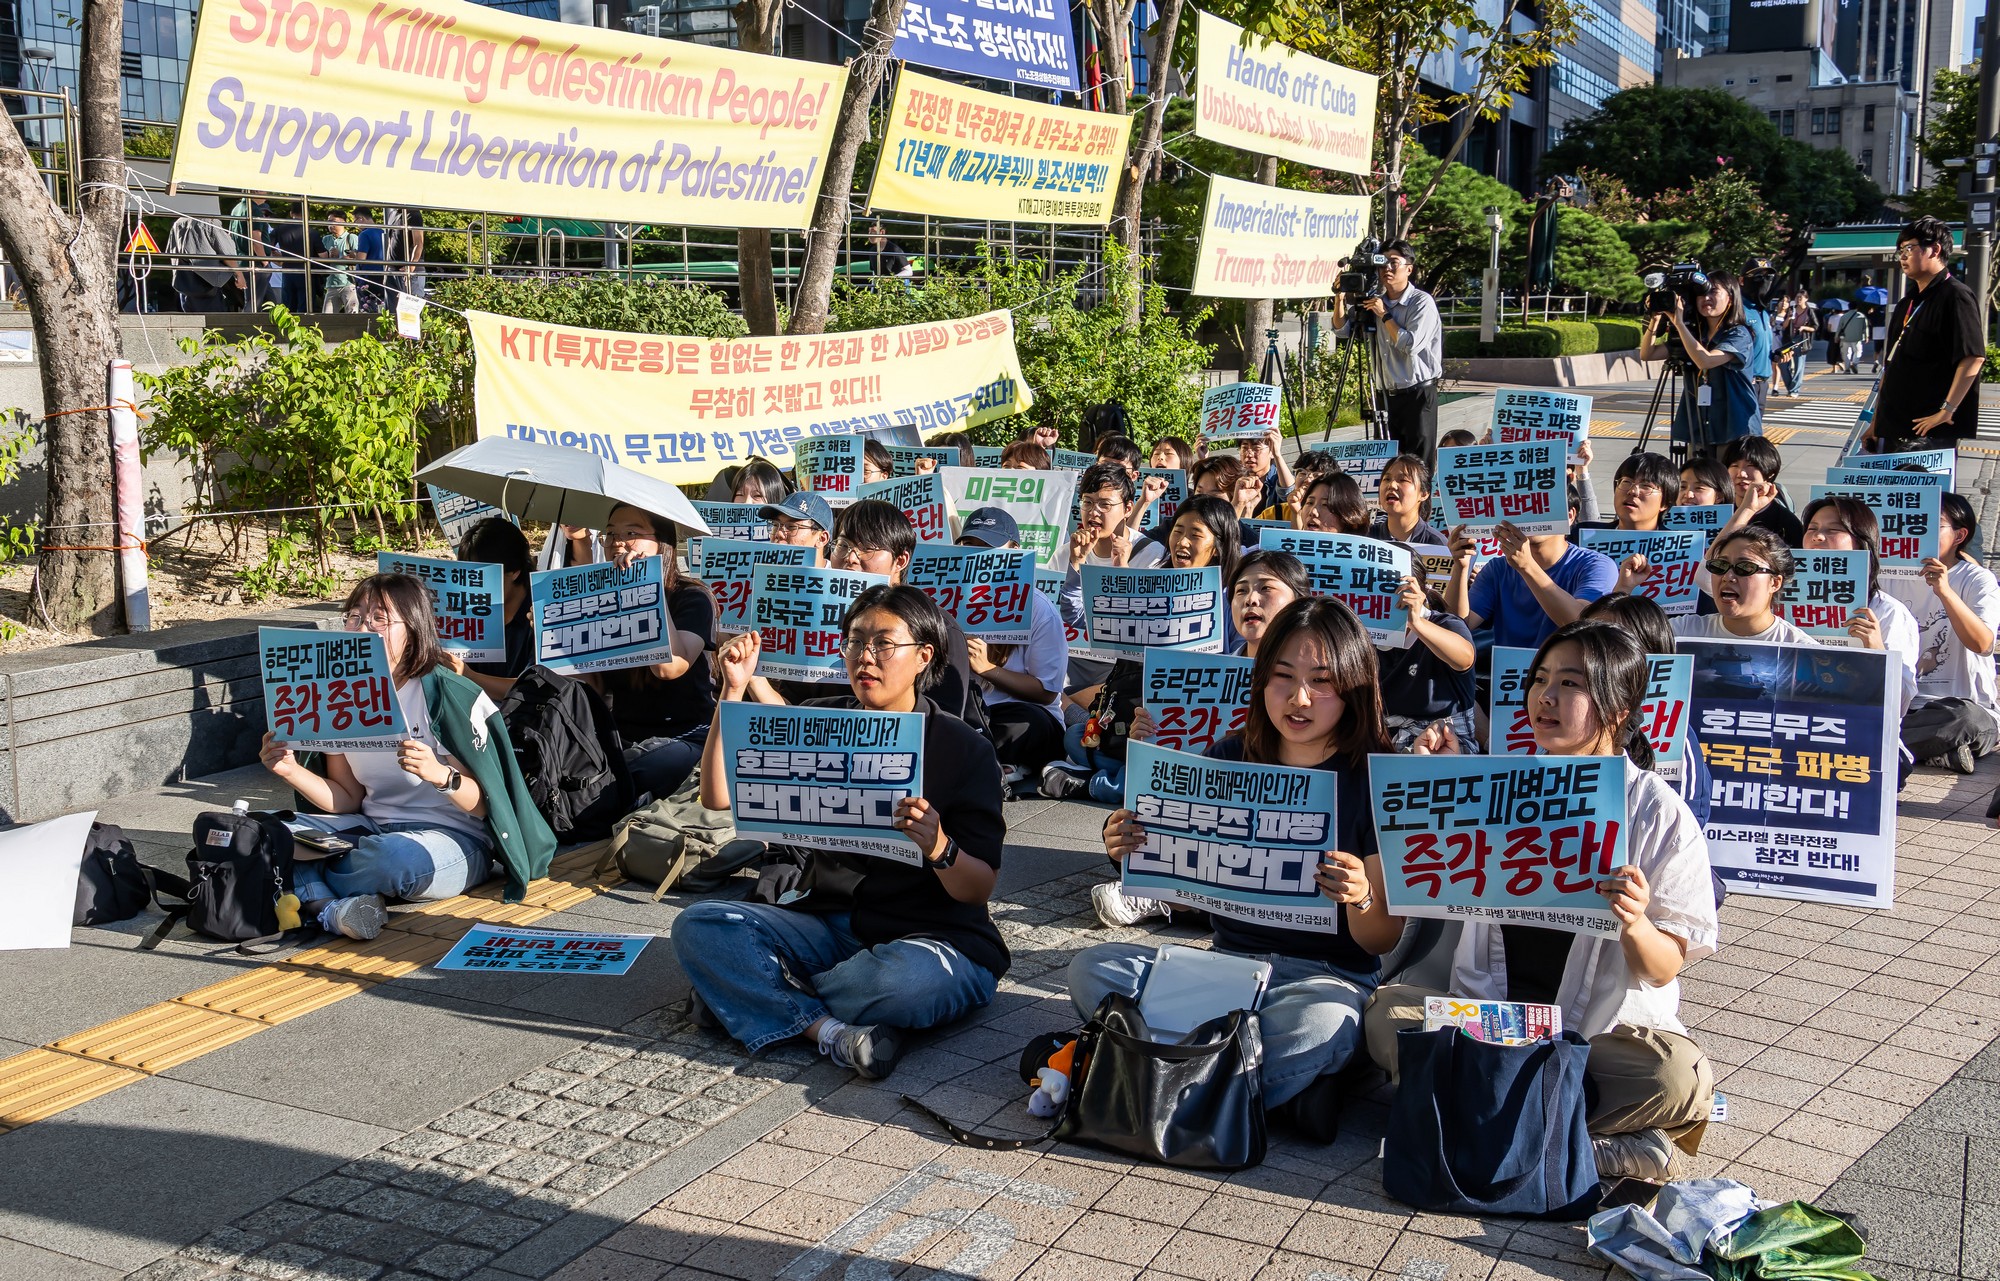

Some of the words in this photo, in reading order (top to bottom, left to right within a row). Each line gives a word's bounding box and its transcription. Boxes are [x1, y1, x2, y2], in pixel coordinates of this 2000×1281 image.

[972, 18, 1069, 70] 쟁취하자!!
[230, 0, 350, 76] Stop
[357, 2, 497, 103] Killing
[500, 36, 703, 118] Palestinian
[707, 67, 830, 140] People!
[1226, 44, 1289, 98] Hands
[1292, 71, 1319, 107] off
[1321, 79, 1356, 116] Cuba
[904, 88, 952, 134] 진정한
[955, 101, 1024, 146] 민주공화국
[1021, 116, 1036, 145] &
[1034, 117, 1087, 153] 민주노조
[1202, 84, 1264, 135] Unblock
[1267, 106, 1304, 146] Cuba!
[1307, 118, 1324, 150] No
[1325, 122, 1369, 161] Invasion!
[198, 77, 412, 177] Support
[410, 110, 617, 190] Liberation
[619, 139, 664, 193] of
[657, 143, 818, 204] Palestine!
[947, 148, 1034, 187] 해고자복직!!
[1214, 193, 1359, 239] Imperialist-Terrorist
[1214, 247, 1267, 287] Trump,
[1271, 252, 1306, 287] Step
[501, 325, 699, 375] KT(투자운용)은
[710, 343, 772, 374] 힘없는
[781, 340, 801, 371] 한
[806, 338, 864, 368] 가정과
[871, 333, 889, 362] 한
[895, 326, 949, 358] 사람의
[953, 315, 1008, 346] 인생을
[689, 381, 755, 419] 무참히
[764, 381, 823, 415] 짓밟고
[830, 374, 882, 407] 있다!!
[1204, 388, 1236, 413] 호르무즈
[1235, 386, 1273, 404] 파병검토
[1505, 394, 1550, 408] 호르무즈
[1554, 397, 1578, 411] 해협
[625, 432, 705, 464] 무고한
[711, 431, 737, 461] 한
[975, 378, 1014, 412] 있다!
[1205, 406, 1236, 434] 즉각
[1237, 403, 1277, 428] 중단!
[1497, 409, 1544, 427] 한국군
[1547, 413, 1581, 431] 파병
[828, 439, 850, 453] 해협
[1454, 451, 1514, 469] 호르무즈
[1519, 447, 1549, 464] 해협
[823, 456, 855, 473] 파병
[812, 474, 850, 492] 반대!
[965, 476, 1045, 504] 미국의
[1444, 472, 1507, 496] 한국군
[1513, 467, 1556, 491] 파병
[1455, 496, 1495, 519] 절대
[1500, 492, 1550, 516] 반대!
[1887, 492, 1920, 508] 해협
[1690, 511, 1717, 524] 해협
[1882, 513, 1928, 536] 파병
[702, 552, 752, 579] 호르무즈
[1280, 538, 1352, 559] 호르무즈
[1358, 543, 1394, 564] 해협
[1813, 557, 1848, 575] 해협
[451, 568, 484, 587] 해협
[552, 572, 586, 600] 청년들이
[588, 560, 648, 593] 방패막이인가?!
[765, 573, 823, 594] 호르무즈
[910, 556, 963, 586] 호르무즈
[962, 552, 1023, 584] 파병검토
[1101, 575, 1136, 594] 청년들이
[1138, 572, 1203, 594] 방패막이인가?!
[1350, 567, 1400, 593] 파병
[1640, 561, 1700, 598] 중단!
[445, 591, 492, 617] 파병
[543, 591, 617, 625] 호르무즈
[620, 581, 658, 609] 파병
[966, 583, 1030, 625] 중단!
[1093, 595, 1168, 614] 호르무즈
[1172, 592, 1214, 613] 파병
[1807, 579, 1855, 604] 파병
[757, 597, 814, 627] 한국군
[1792, 604, 1846, 629] 반대!
[434, 616, 484, 641] 반대!
[541, 608, 660, 660] 반대한다
[760, 627, 797, 655] 절대
[1093, 614, 1213, 644] 반대한다
[265, 643, 313, 683] 호르무즈
[316, 637, 373, 679] 파병검토
[1147, 668, 1221, 705] 호르무즈
[273, 681, 322, 736] 즉각
[327, 676, 392, 731] 중단!
[749, 716, 801, 746] 청년들이
[803, 716, 900, 747] 방패막이인가?!
[1155, 705, 1222, 751] 즉각
[1700, 708, 1846, 745] 호르무즈
[735, 748, 849, 781] 호르무즈
[851, 752, 917, 784] 파병
[1796, 750, 1871, 784] 파병
[1150, 760, 1202, 797] 청년들이
[1205, 769, 1311, 806] 방패막이인가?!
[1380, 774, 1484, 832] 호르무즈
[1485, 763, 1601, 826] 파병검토
[1135, 794, 1254, 841] 호르무즈
[1255, 809, 1330, 845] 파병
[782, 832, 810, 842] 호르무즈
[812, 835, 827, 845] 파병
[828, 837, 859, 849] 절대반대
[860, 840, 890, 853] 청년학생
[891, 846, 919, 860] 긴급집회
[1774, 833, 1838, 850] 침략전쟁
[1128, 830, 1325, 897] 반대한다
[1401, 829, 1493, 899] 즉각
[1500, 820, 1620, 897] 중단!
[1755, 847, 1799, 866] 참전
[1807, 851, 1860, 872] 반대!
[1175, 888, 1205, 903] 호르무즈
[1206, 897, 1222, 909] 파병
[1223, 901, 1256, 918] 절대반대
[1257, 909, 1293, 923] 청년학생
[1295, 913, 1332, 927] 긴급집회
[1446, 904, 1484, 916] 호르무즈
[1485, 908, 1504, 919] 파병
[1506, 909, 1545, 922] 절대반대
[1547, 911, 1585, 927] 청년학생
[1587, 916, 1619, 932] 긴급집회
